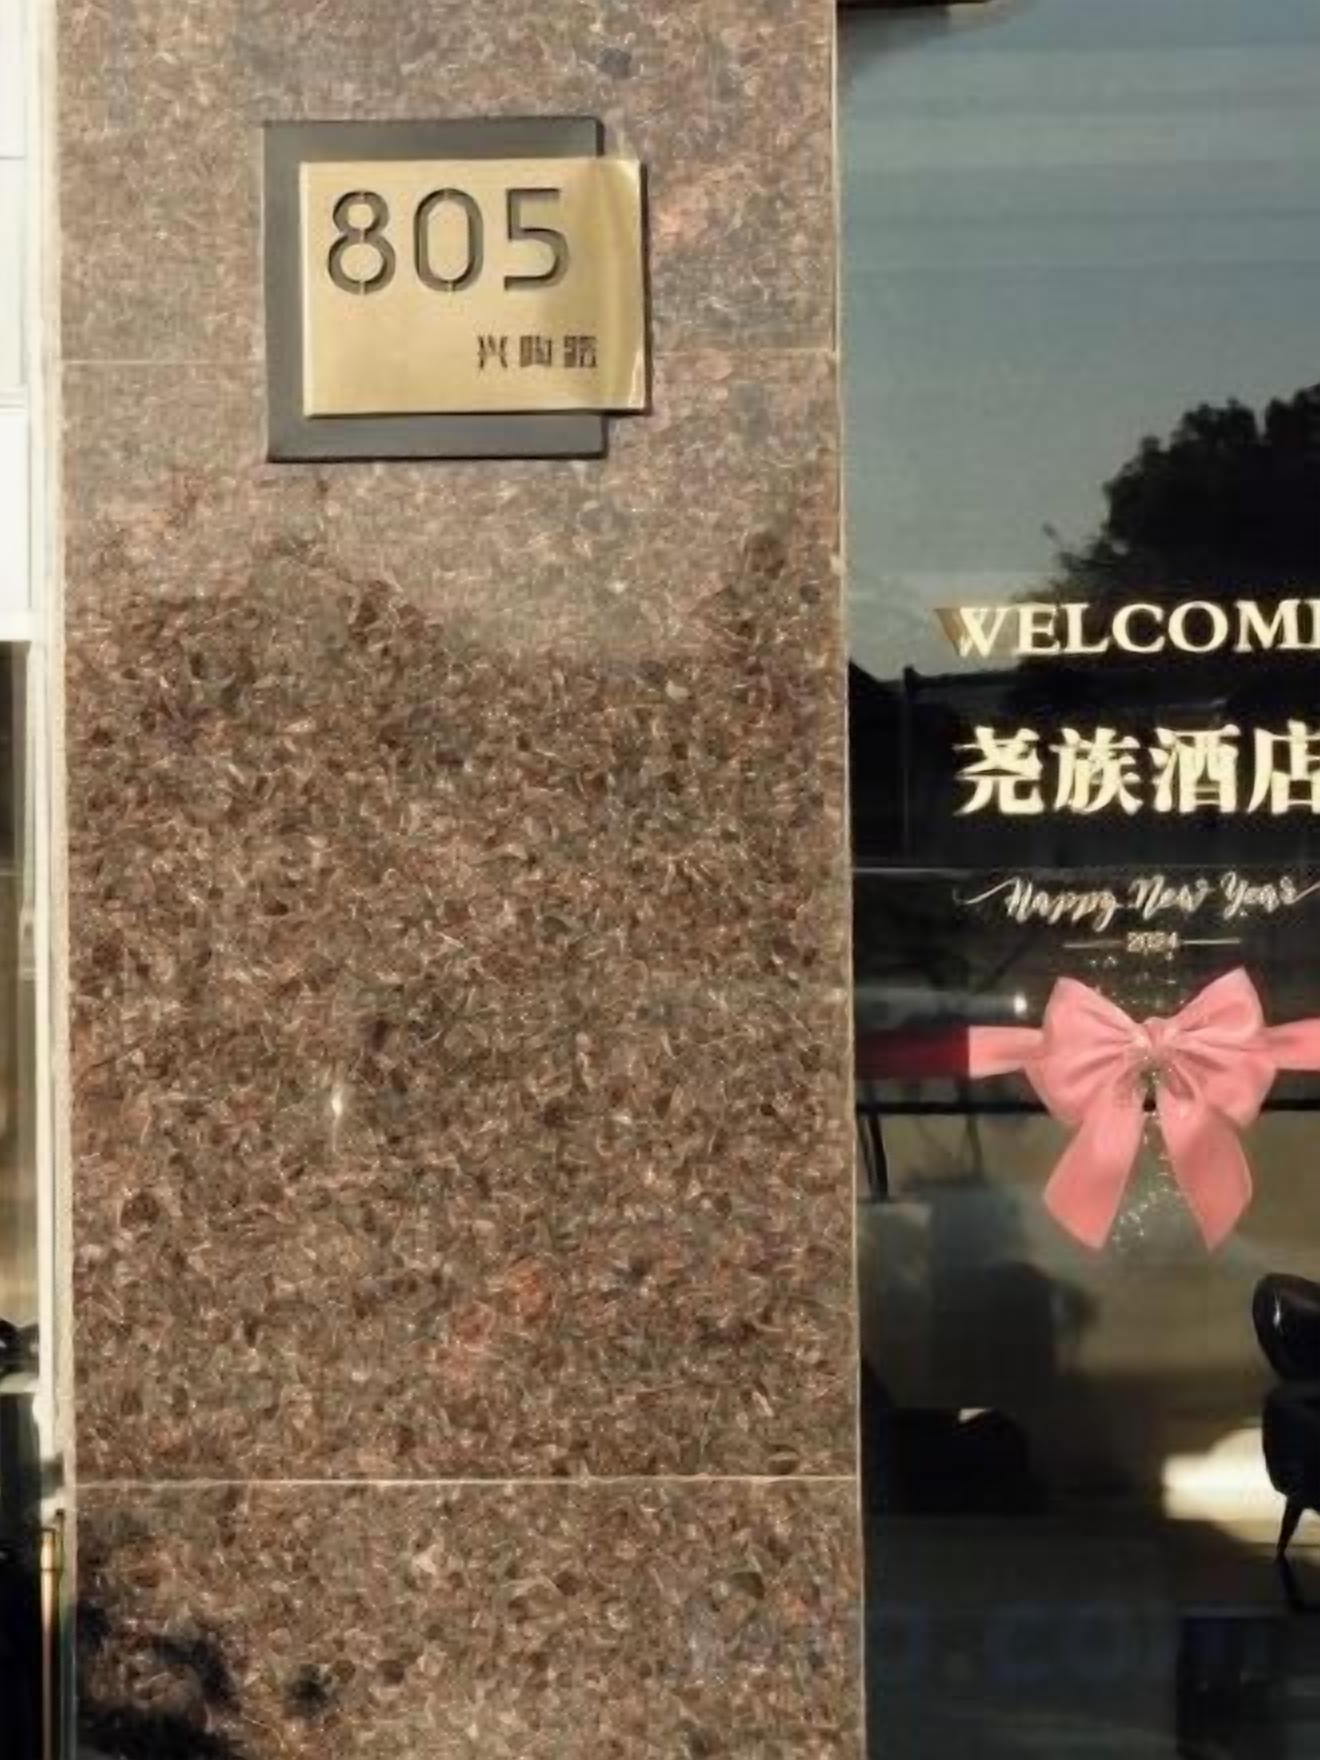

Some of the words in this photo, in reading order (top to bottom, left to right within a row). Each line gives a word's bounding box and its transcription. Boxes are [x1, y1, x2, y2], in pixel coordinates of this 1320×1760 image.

[327, 187, 569, 295] 805
[954, 720, 1320, 816] 尧族酒店
[958, 876, 1121, 932] Happy
[1129, 873, 1212, 921] New
